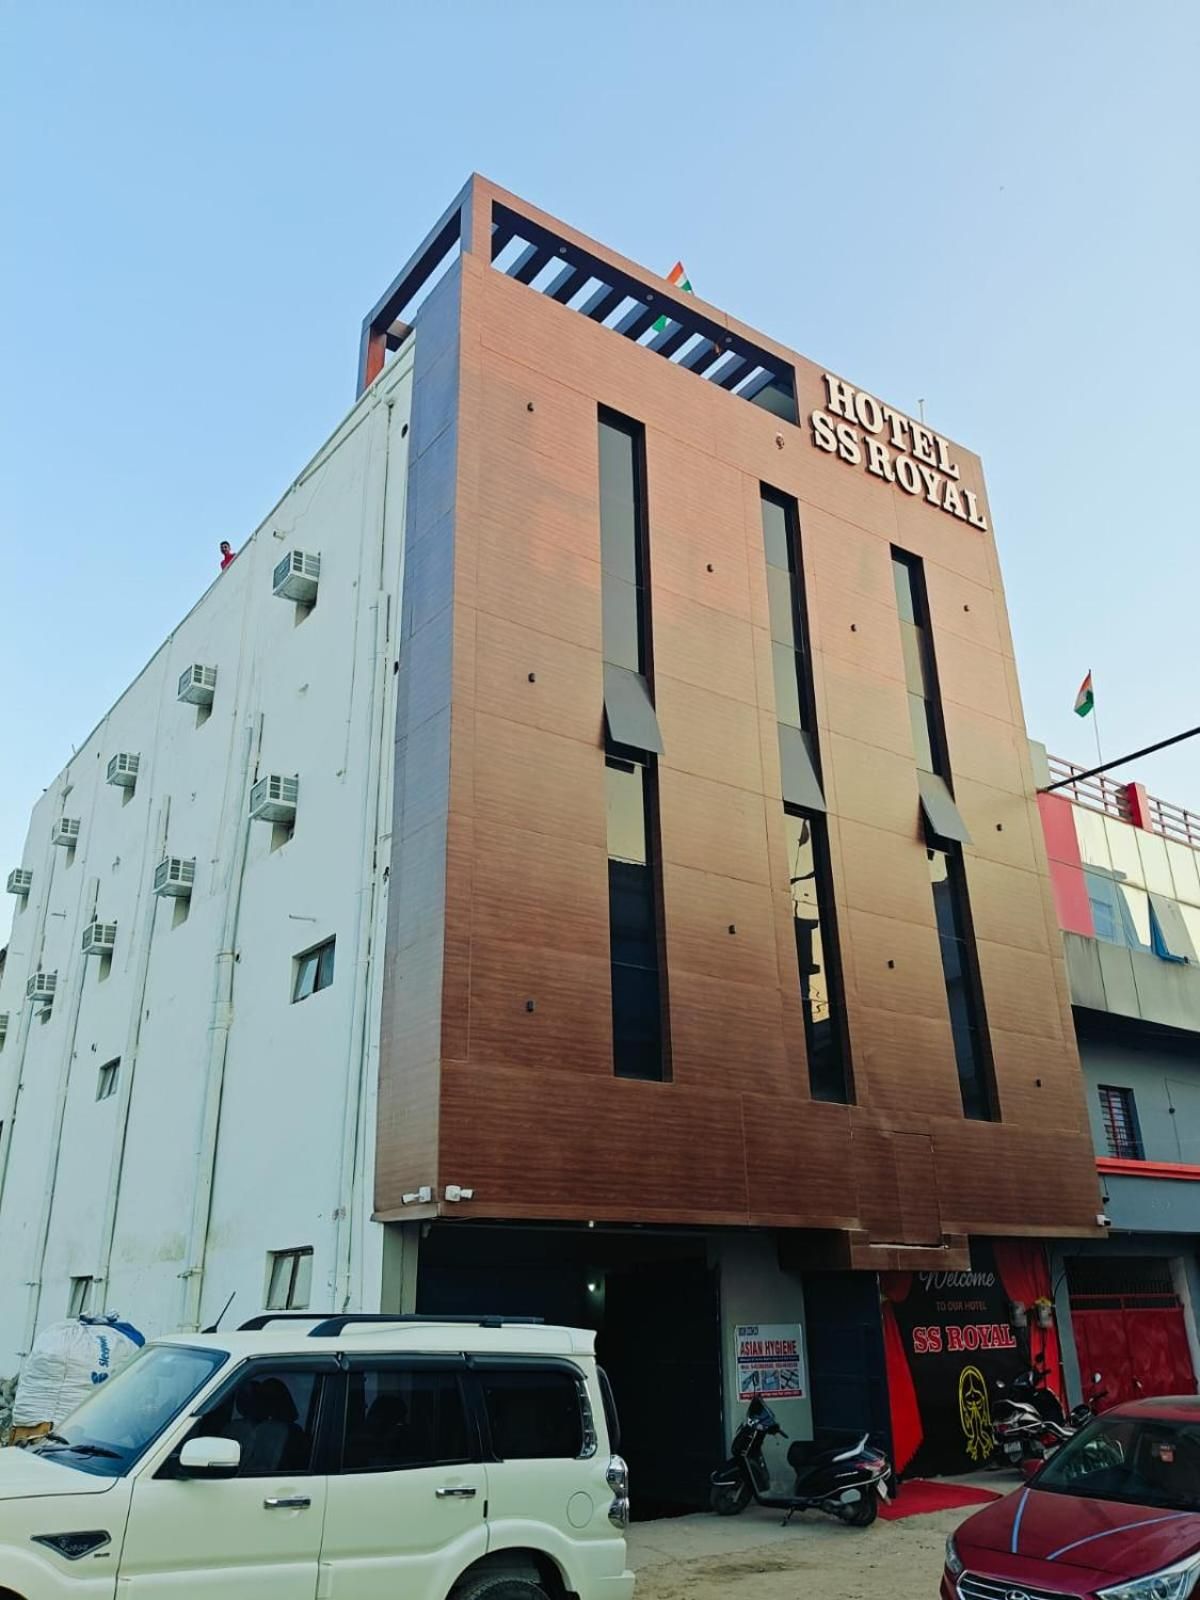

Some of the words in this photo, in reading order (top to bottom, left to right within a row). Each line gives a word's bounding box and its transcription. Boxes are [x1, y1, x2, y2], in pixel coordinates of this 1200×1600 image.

[824, 374, 960, 480] HOTEL
[811, 409, 862, 465] SS
[865, 436, 987, 532] ROYAL
[918, 1271, 996, 1291] Welcome
[936, 1301, 946, 1312] TO
[947, 1301, 963, 1311] OUR
[964, 1301, 987, 1311] HOTEL
[740, 1340, 763, 1356] ASIAN
[765, 1339, 797, 1355] HYGIENE
[912, 1326, 943, 1353] SS
[945, 1324, 1017, 1351] ROYAL
